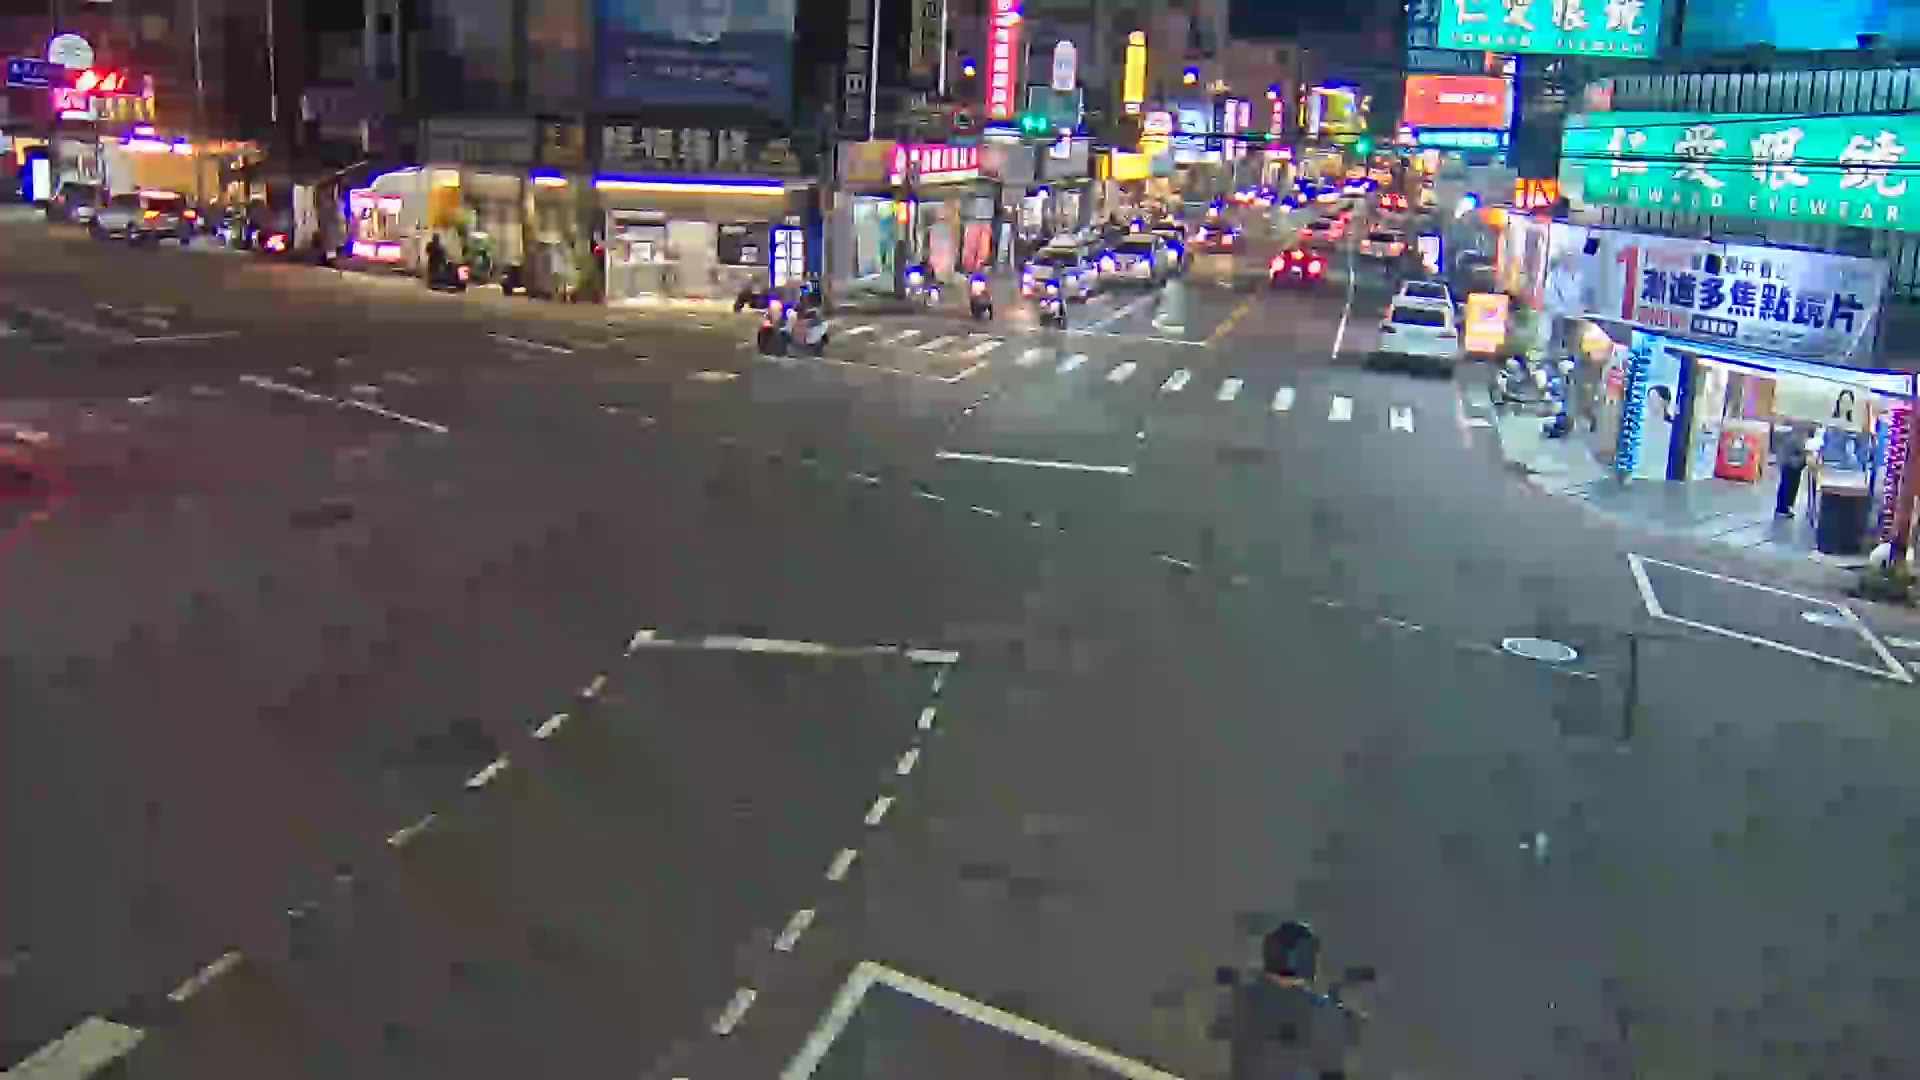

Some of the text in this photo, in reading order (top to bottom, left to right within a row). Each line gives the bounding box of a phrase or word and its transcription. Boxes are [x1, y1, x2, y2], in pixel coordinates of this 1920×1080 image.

[1607, 124, 1908, 197] 仁愛眼鏡
[1748, 196, 1899, 221] EYEWEAR
